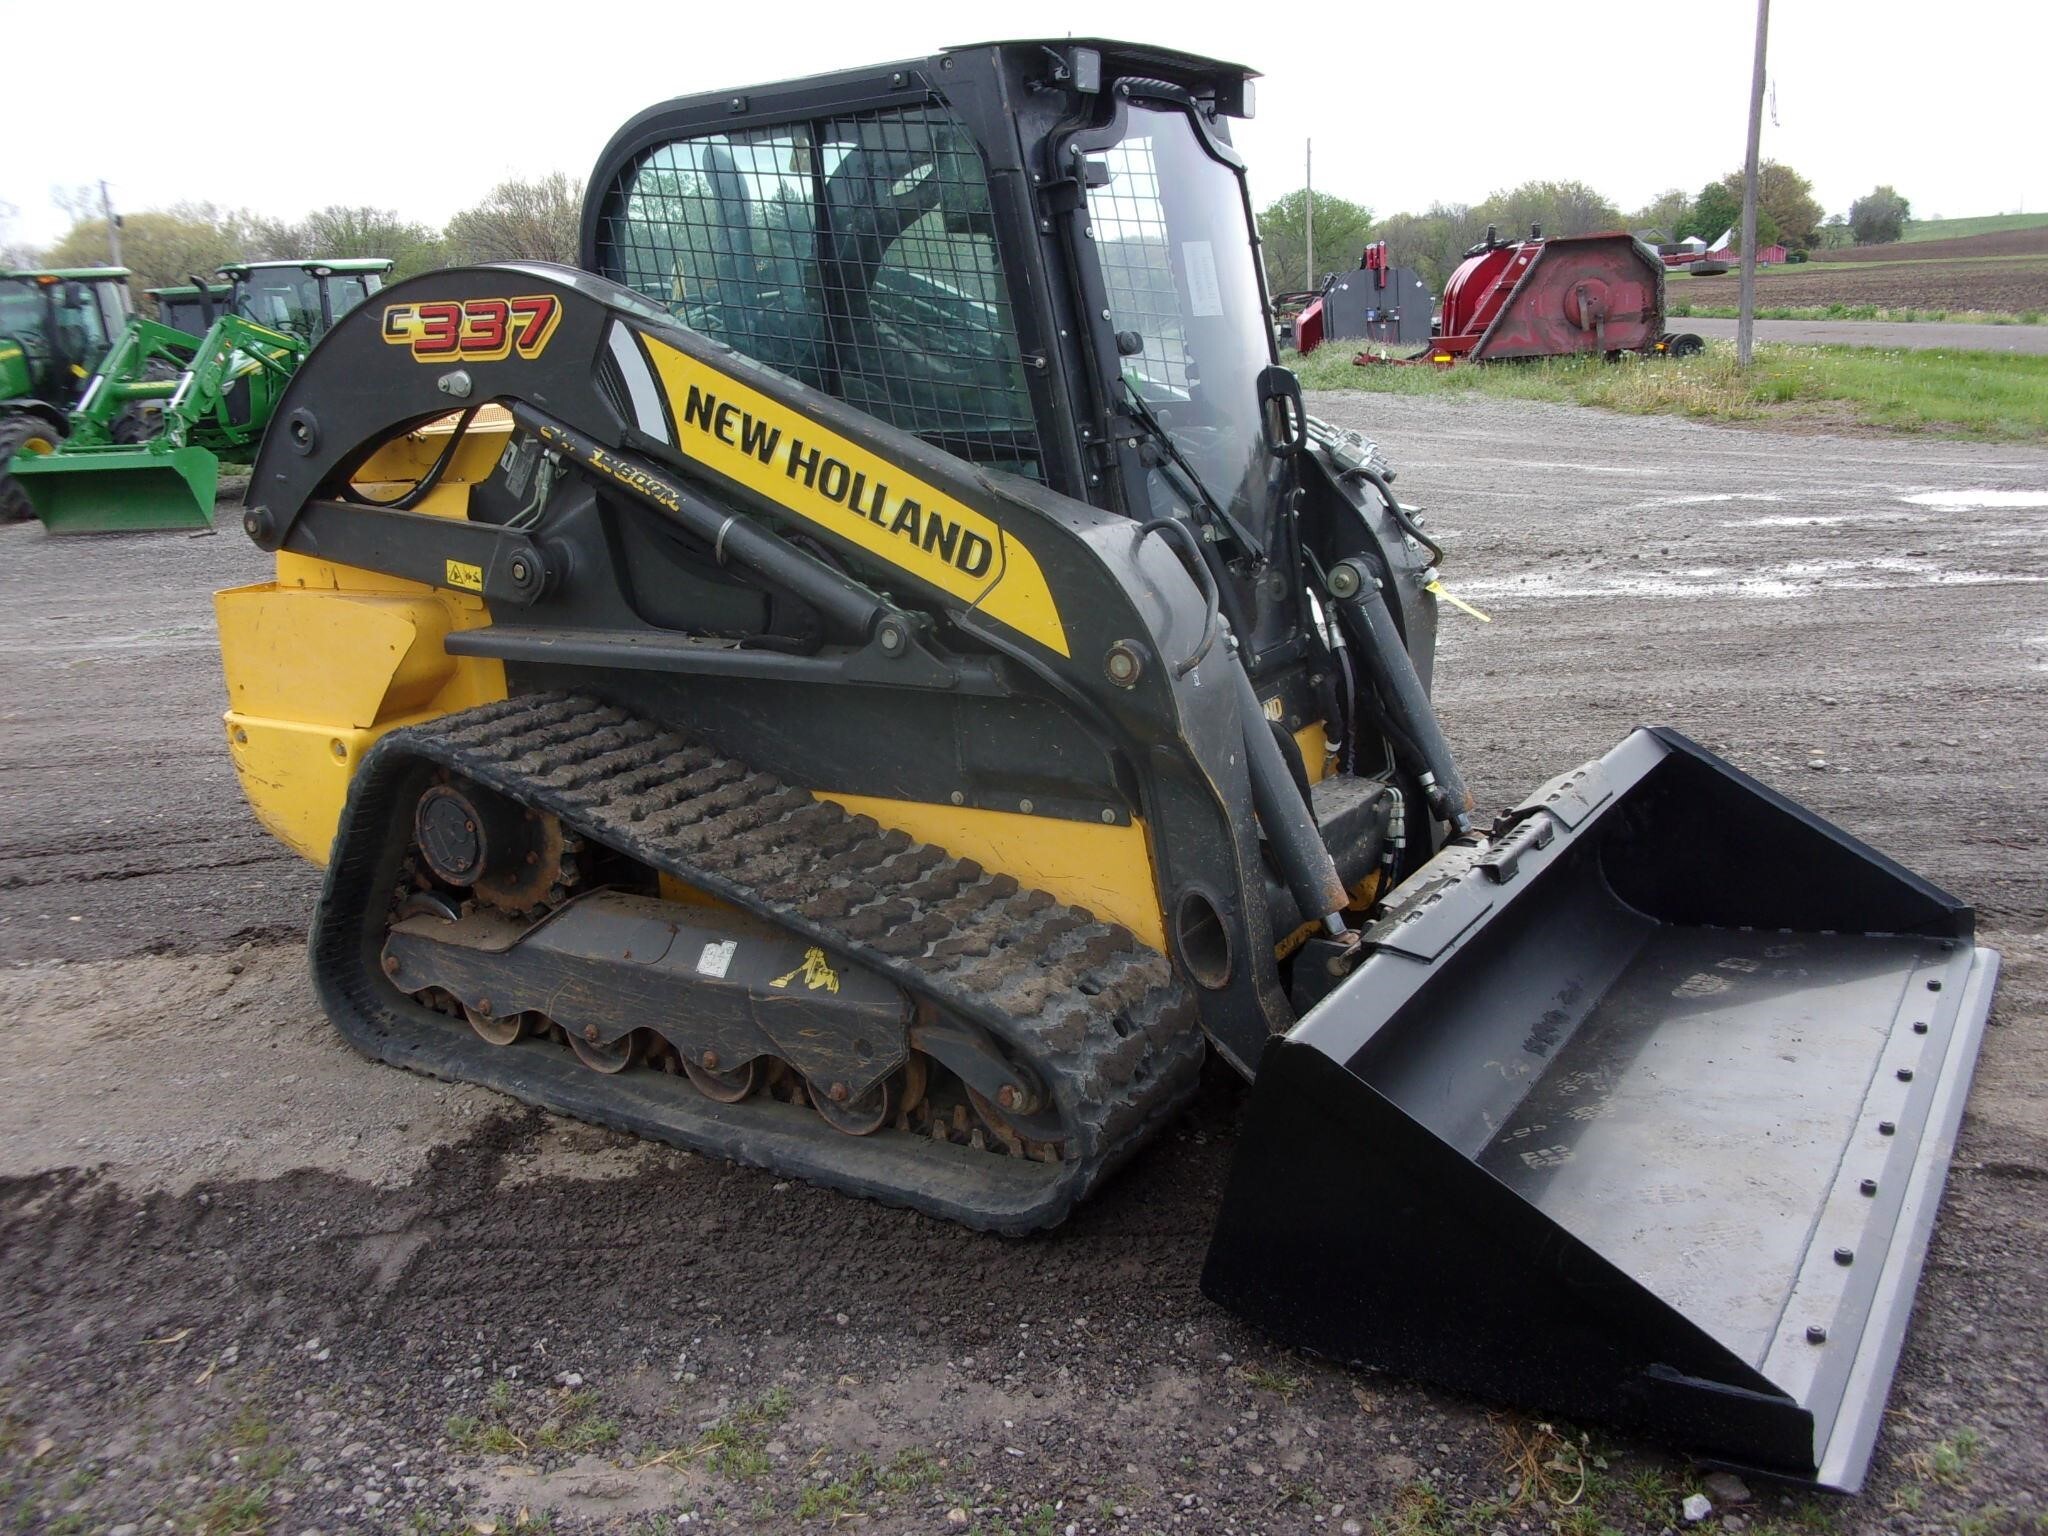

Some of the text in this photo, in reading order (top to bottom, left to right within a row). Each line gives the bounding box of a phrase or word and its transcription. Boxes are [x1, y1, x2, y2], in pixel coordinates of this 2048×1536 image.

[384, 295, 561, 362] C337
[684, 384, 782, 465] NEW
[786, 438, 993, 579] HOLLAND
